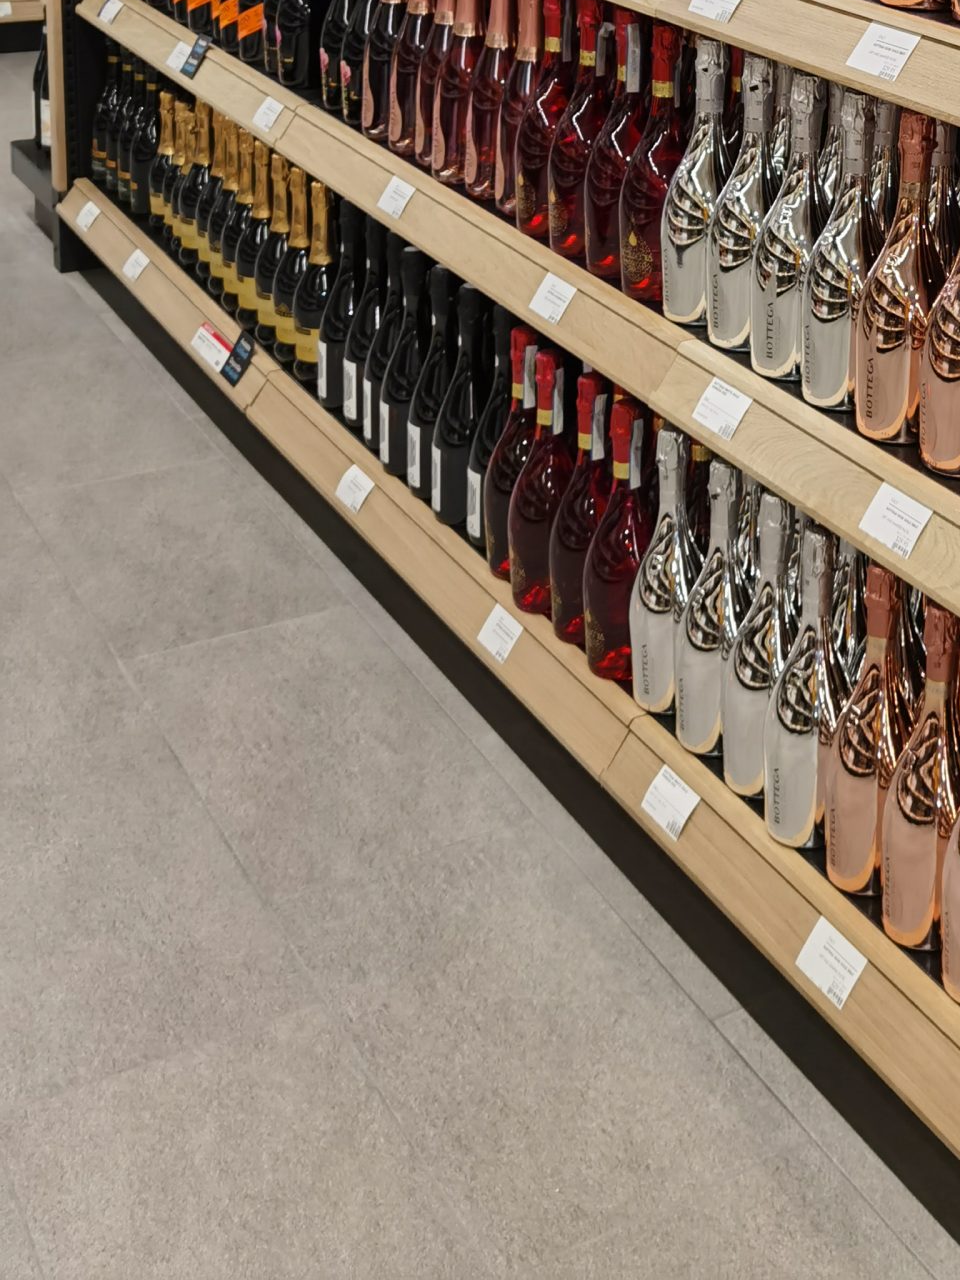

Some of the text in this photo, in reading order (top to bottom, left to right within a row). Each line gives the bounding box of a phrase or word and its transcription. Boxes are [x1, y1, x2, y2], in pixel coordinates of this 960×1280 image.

[713, 273, 721, 329] BOTTEGA
[766, 301, 774, 359] BOTTEGA
[866, 357, 875, 419] BOTTEGA
[642, 643, 650, 695] BOTTEGA
